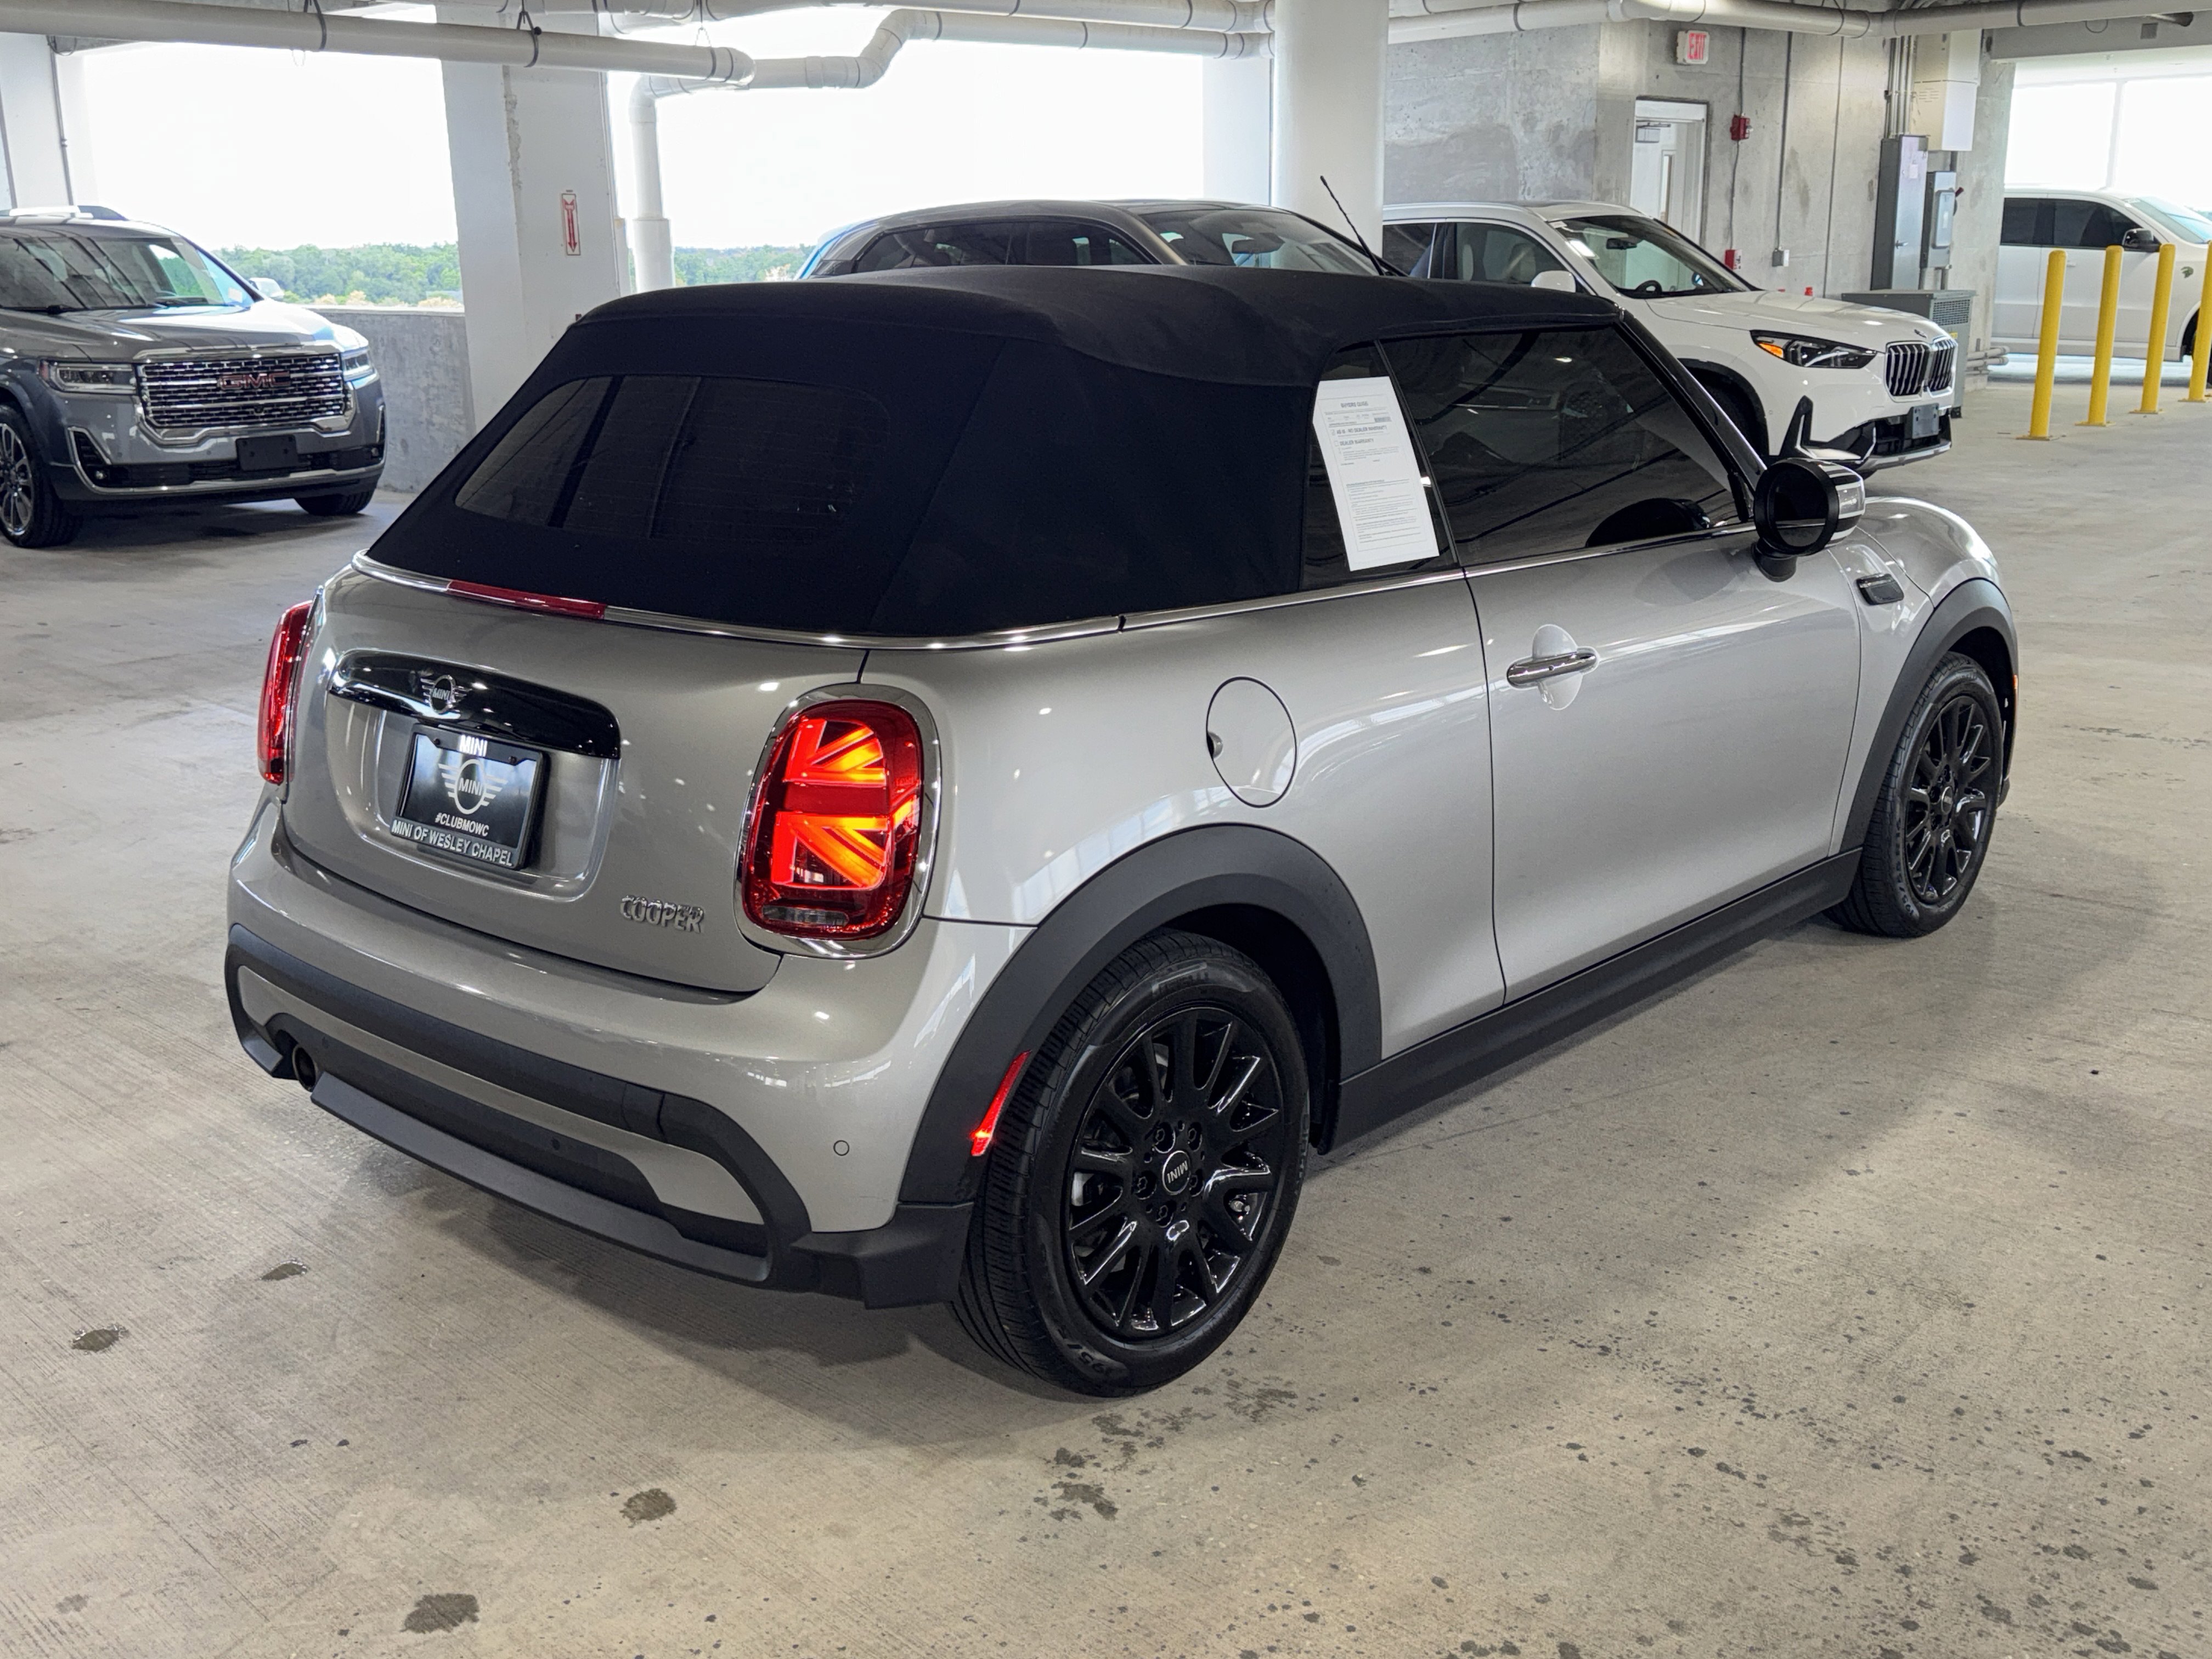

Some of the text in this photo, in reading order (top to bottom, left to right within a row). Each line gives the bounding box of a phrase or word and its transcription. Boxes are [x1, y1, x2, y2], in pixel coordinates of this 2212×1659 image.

[1688, 33, 1706, 60] EXIT
[217, 371, 291, 390] GMC
[432, 687, 450, 700] MINI
[459, 734, 488, 757] MINI
[458, 777, 483, 795] MINI
[435, 812, 489, 837] #CLUBMOWC
[391, 820, 512, 866] MINI OF WESLEY CHAPEL
[620, 895, 704, 933] COOPER
[1167, 1160, 1188, 1183] MINI
